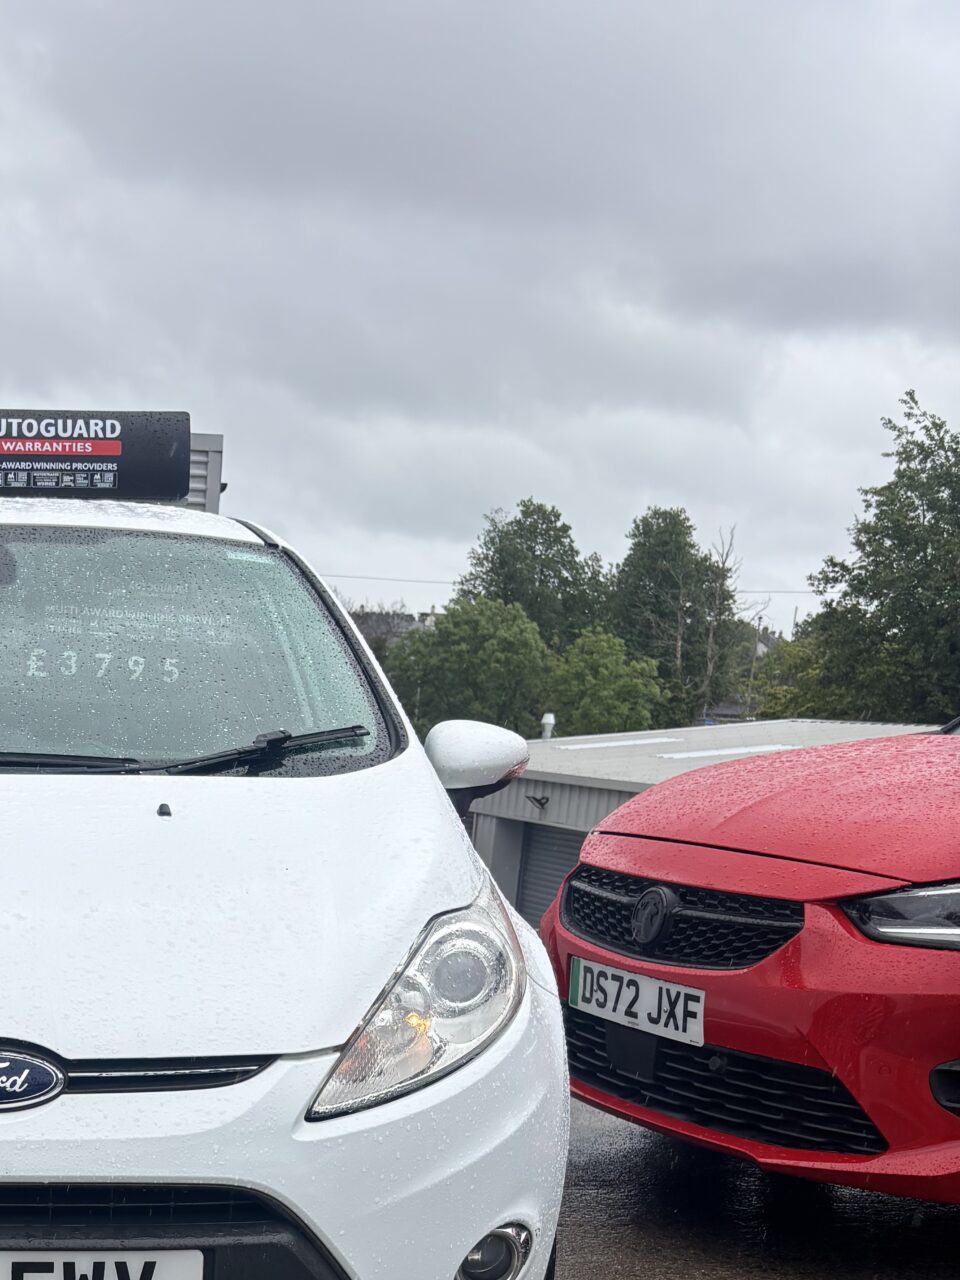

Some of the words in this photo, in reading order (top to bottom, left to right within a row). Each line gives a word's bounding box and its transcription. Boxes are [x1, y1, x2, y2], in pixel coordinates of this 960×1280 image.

[2, 441, 93, 453] WARRANTIES
[33, 462, 71, 470] WINNING
[72, 463, 118, 471] PROVIDERS
[26, 648, 180, 683] £3795
[581, 965, 640, 1020] DS72
[647, 986, 701, 1034] JXF
